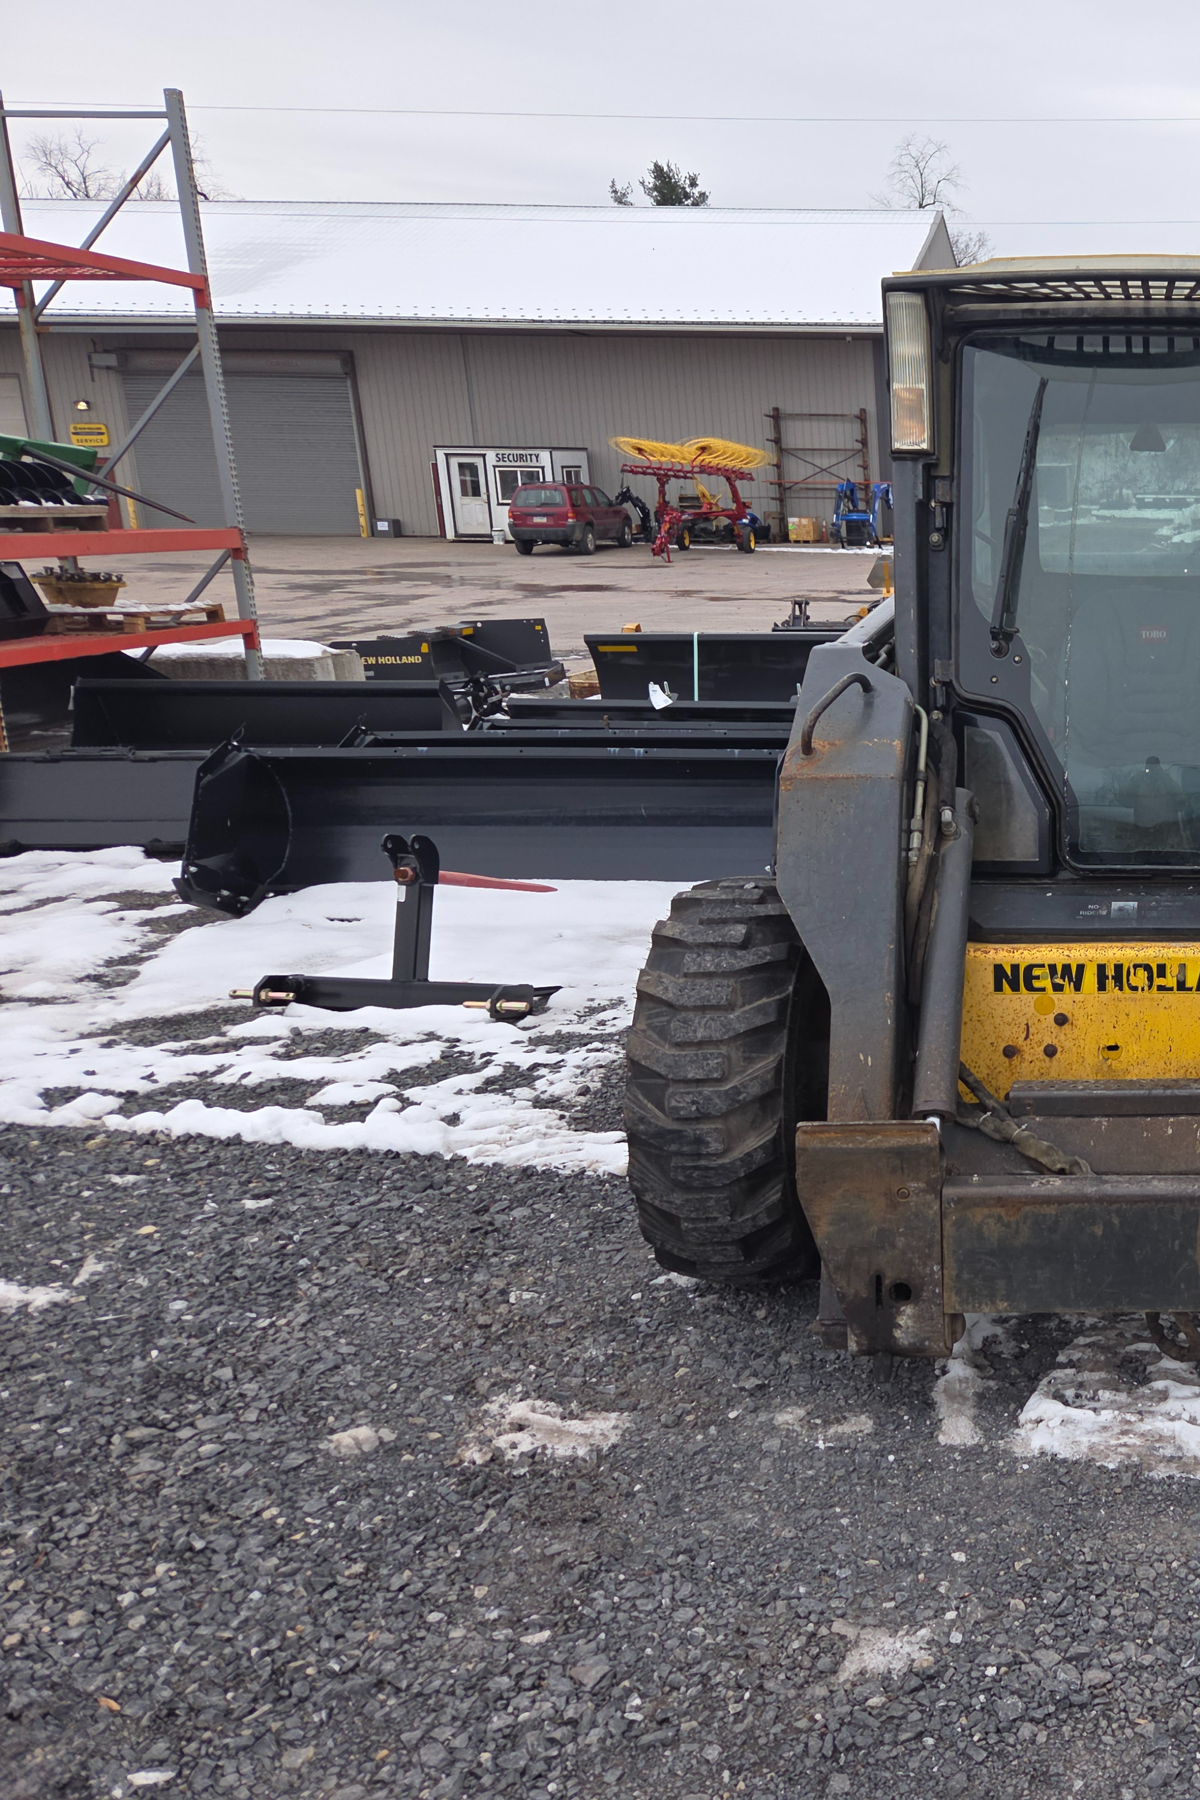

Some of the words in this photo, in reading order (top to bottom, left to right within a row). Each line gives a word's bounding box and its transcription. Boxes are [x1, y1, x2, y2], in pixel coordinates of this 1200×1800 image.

[495, 453, 540, 463] SECURITY
[1140, 630, 1167, 639] TORO
[360, 656, 376, 665] EW
[378, 655, 422, 664] HOLLAND
[993, 963, 1086, 993] NEW
